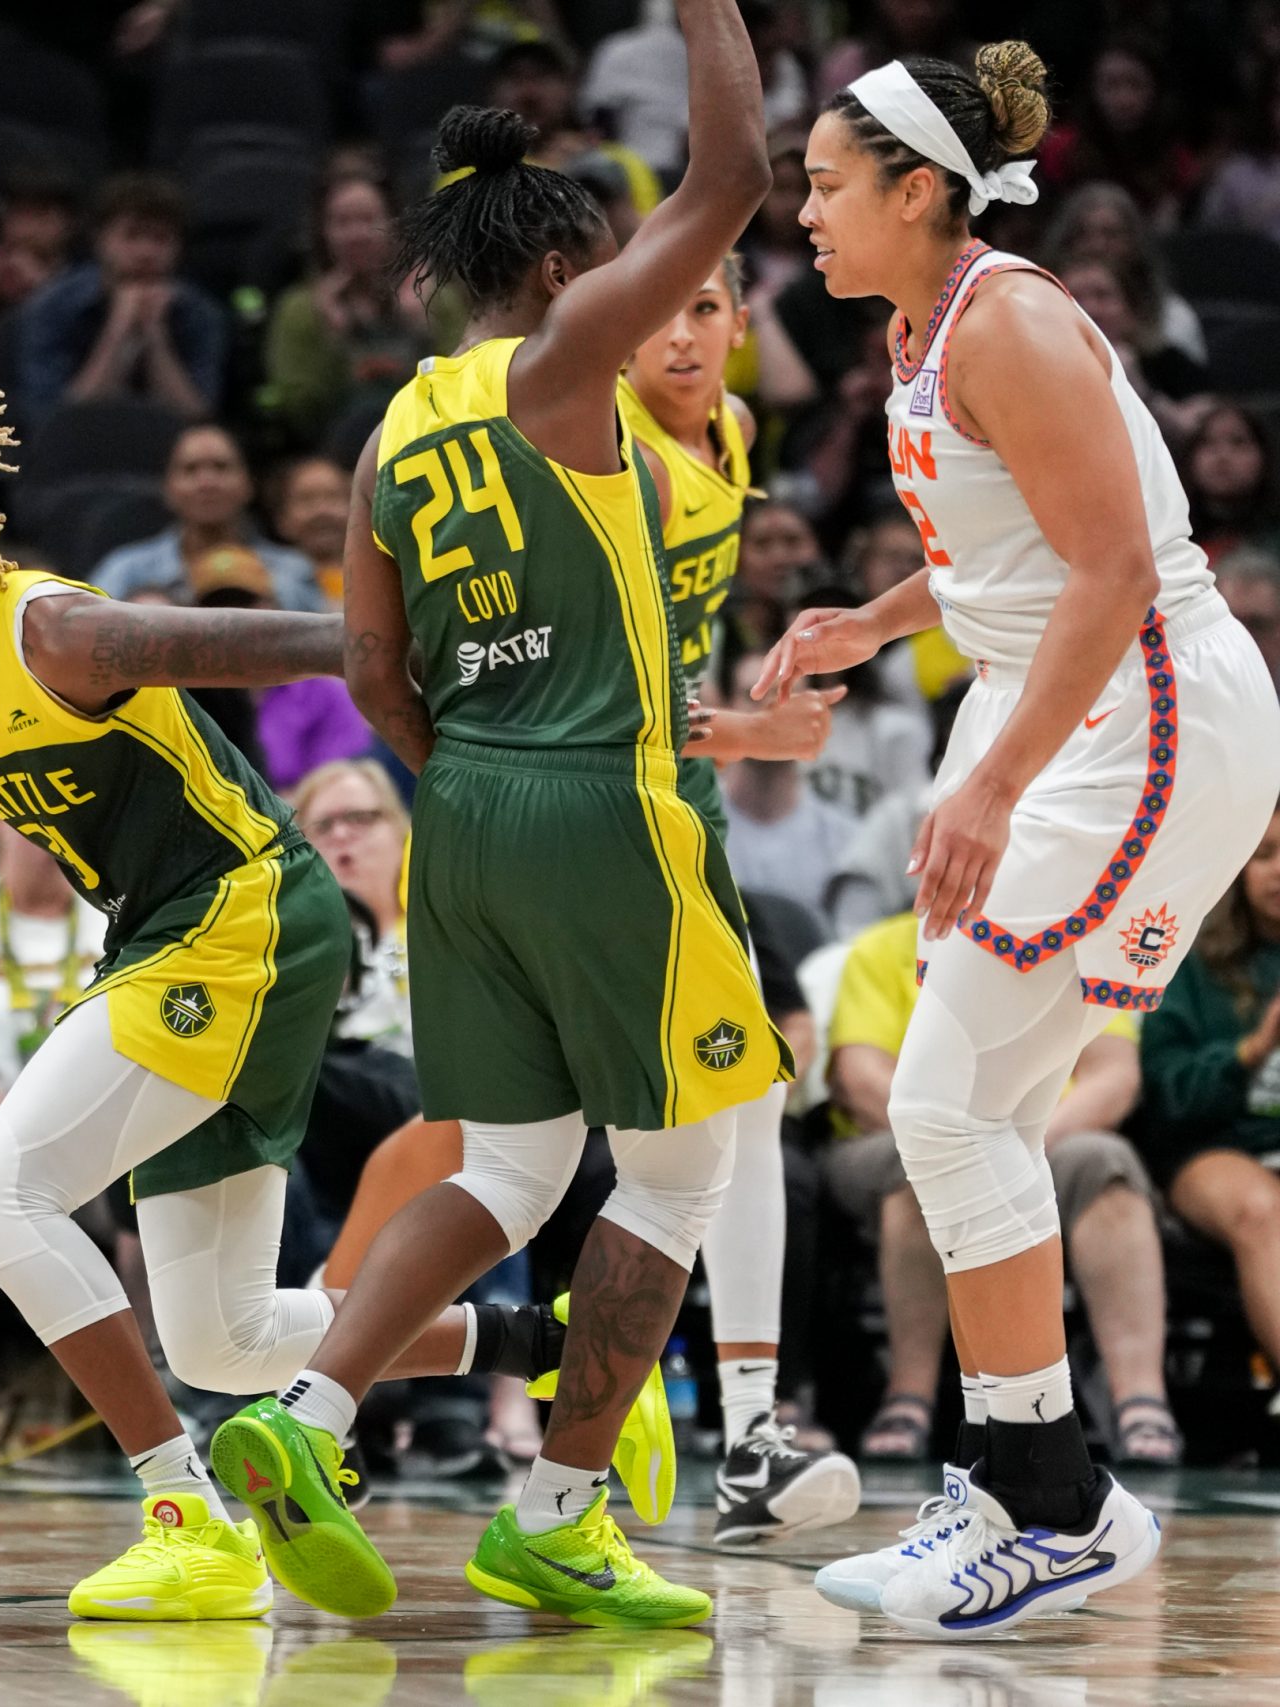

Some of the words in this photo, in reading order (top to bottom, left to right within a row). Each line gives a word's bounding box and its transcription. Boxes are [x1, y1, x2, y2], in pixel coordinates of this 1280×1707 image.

[394, 427, 524, 583] 24
[456, 570, 518, 624] LOYD
[488, 625, 553, 671] AT&T
